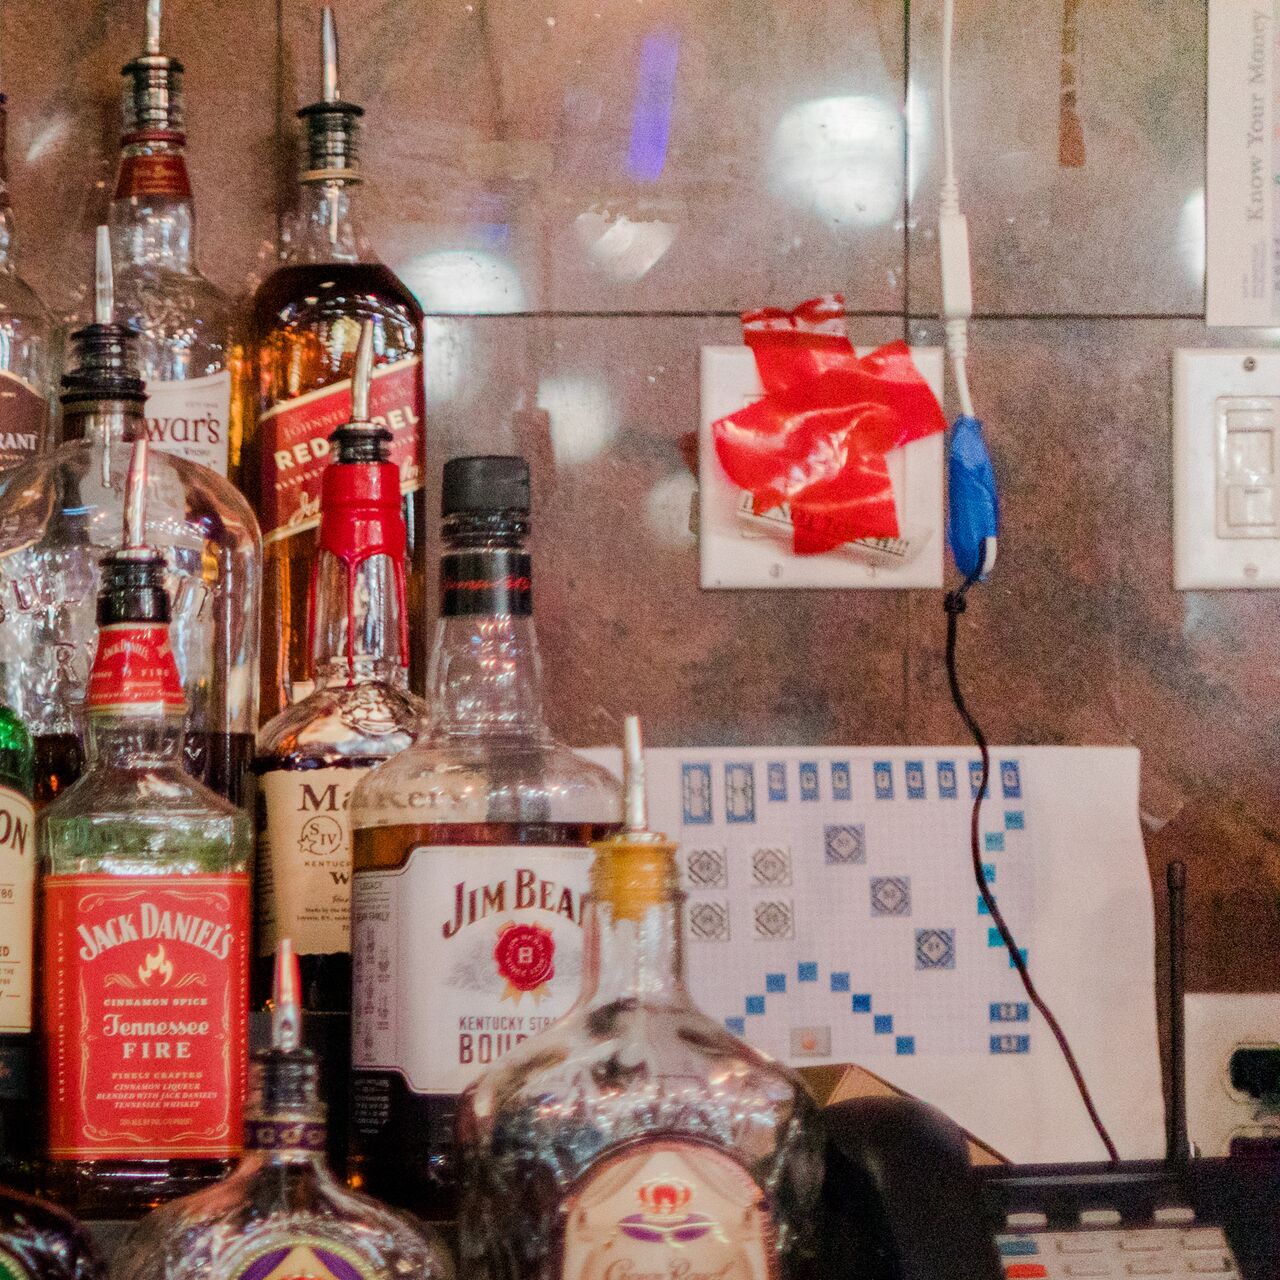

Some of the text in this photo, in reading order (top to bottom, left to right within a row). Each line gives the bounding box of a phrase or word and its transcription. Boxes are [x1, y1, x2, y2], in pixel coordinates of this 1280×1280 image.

[146, 411, 221, 445] war's
[274, 437, 331, 471] RED
[304, 860, 352, 868] KENTUC
[442, 880, 507, 940] JIM
[78, 902, 236, 962] JACK DANIEL'S
[102, 997, 171, 1008] CINNAMON
[102, 1013, 210, 1037] Tennessee
[458, 1015, 524, 1031] KENTUCKY
[122, 1042, 193, 1060] FIRE
[113, 1083, 201, 1092] CINNAMON LIQUEUR
